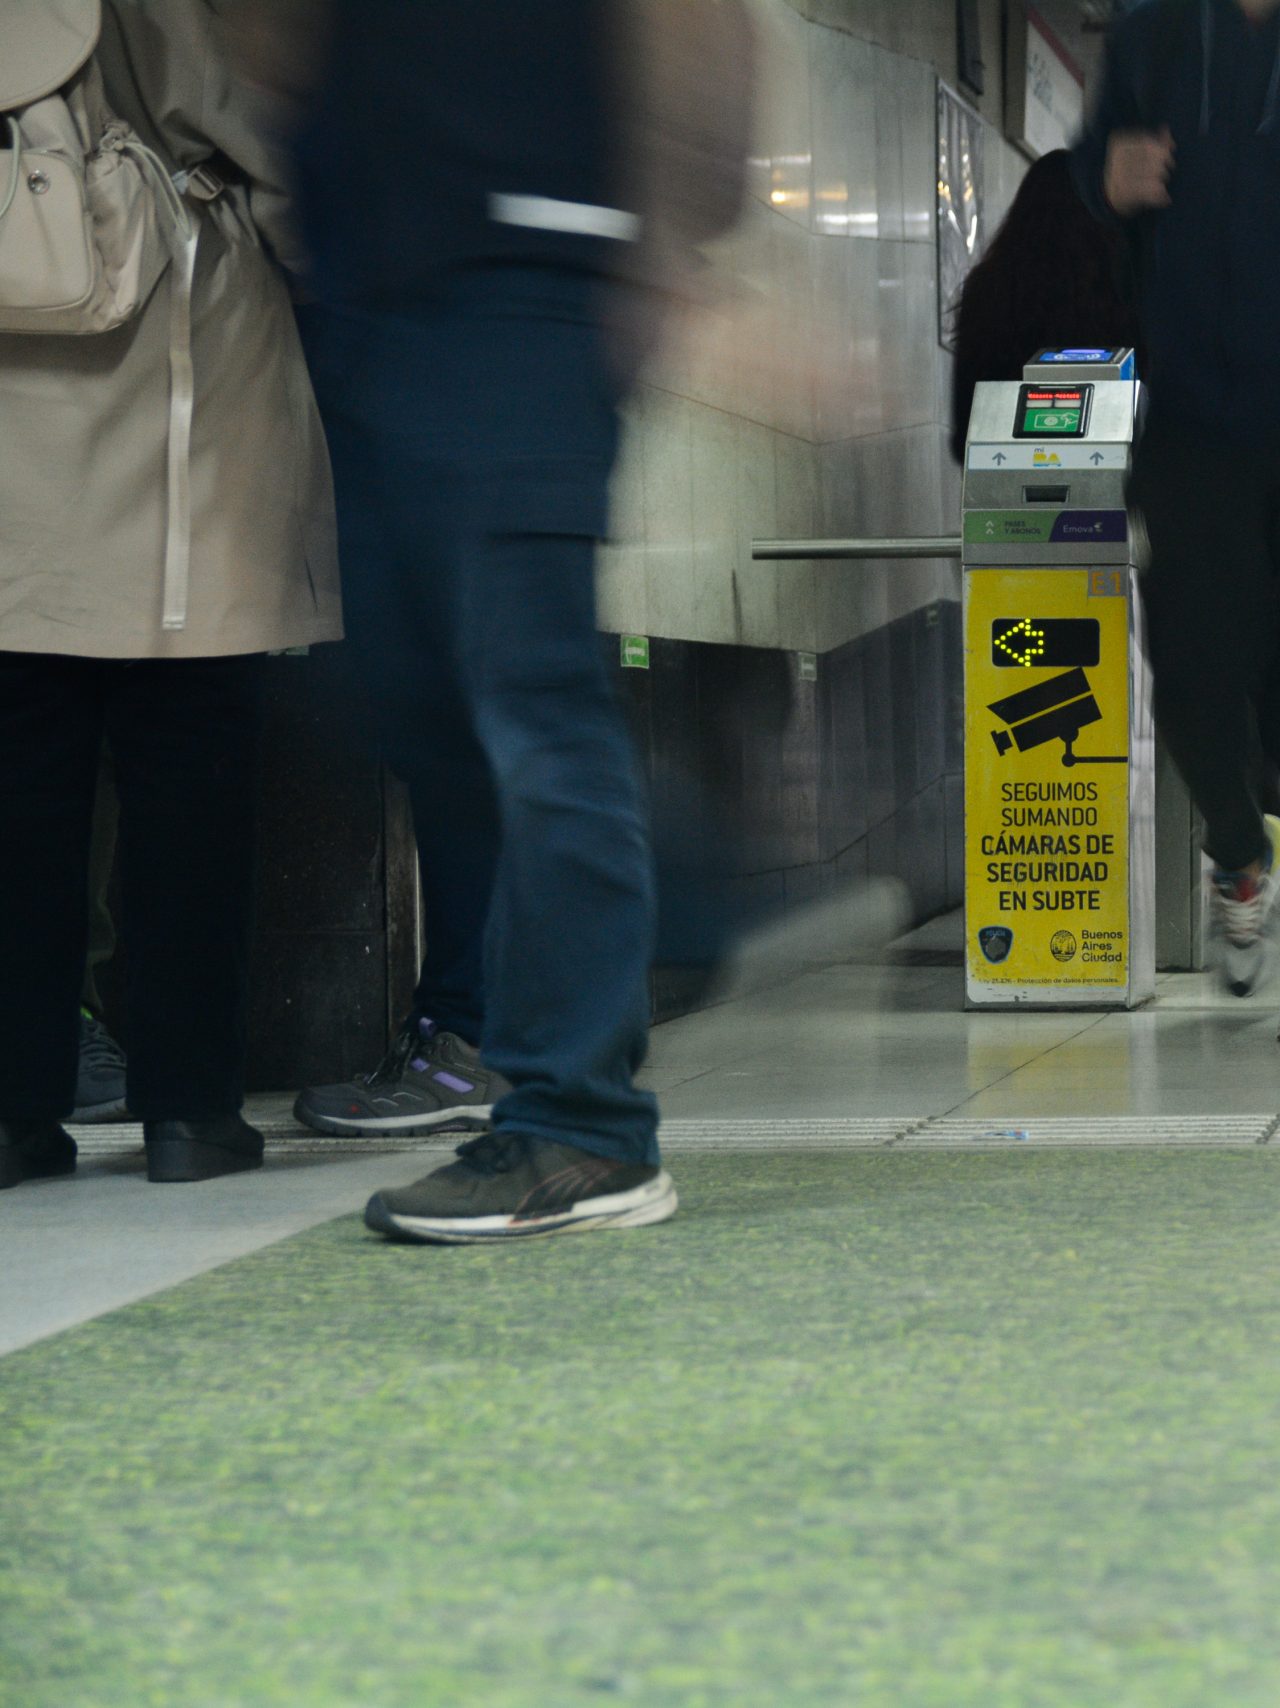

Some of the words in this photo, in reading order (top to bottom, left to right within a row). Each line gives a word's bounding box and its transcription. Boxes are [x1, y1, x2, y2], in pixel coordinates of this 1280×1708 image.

[1063, 524, 1093, 533] Emova
[1091, 572, 1121, 594] E1
[1001, 782, 1098, 802] SEGUIMOS
[1001, 807, 1098, 827] SUMANDO
[981, 831, 1081, 856] CÁMARAS
[1086, 835, 1115, 855] DE
[987, 862, 1109, 883] SEGURIDAD
[999, 891, 1028, 911] EN
[1033, 890, 1101, 911] SUBTE
[1081, 930, 1123, 939] Buenos
[1081, 942, 1113, 951] Aires
[1081, 953, 1122, 962] Ciudad
